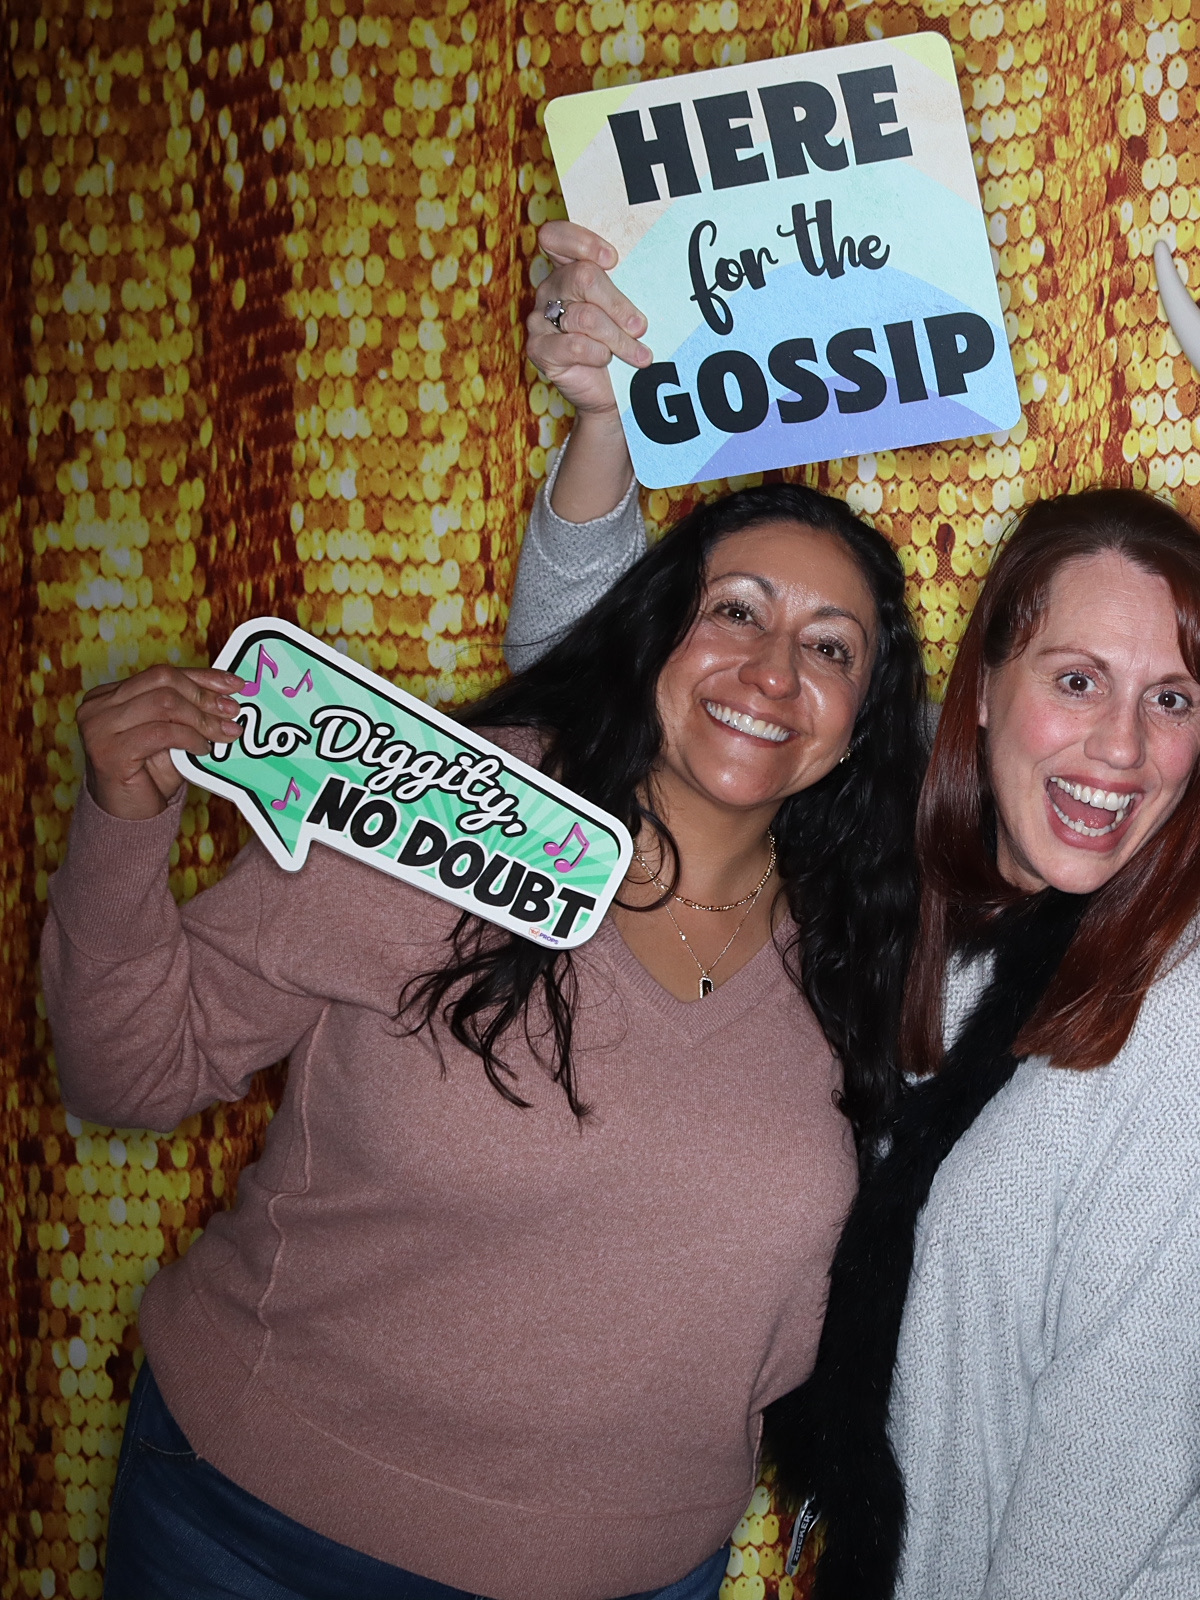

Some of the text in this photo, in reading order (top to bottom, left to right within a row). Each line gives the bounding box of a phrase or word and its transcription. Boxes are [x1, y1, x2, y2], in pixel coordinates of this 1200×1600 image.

[607, 65, 913, 205] HERE
[688, 199, 890, 335] for the
[629, 312, 995, 444] GOSSIP
[310, 704, 527, 838] Diggity,
[307, 777, 596, 938] NO DOUBT
[539, 932, 559, 945] PROPS
